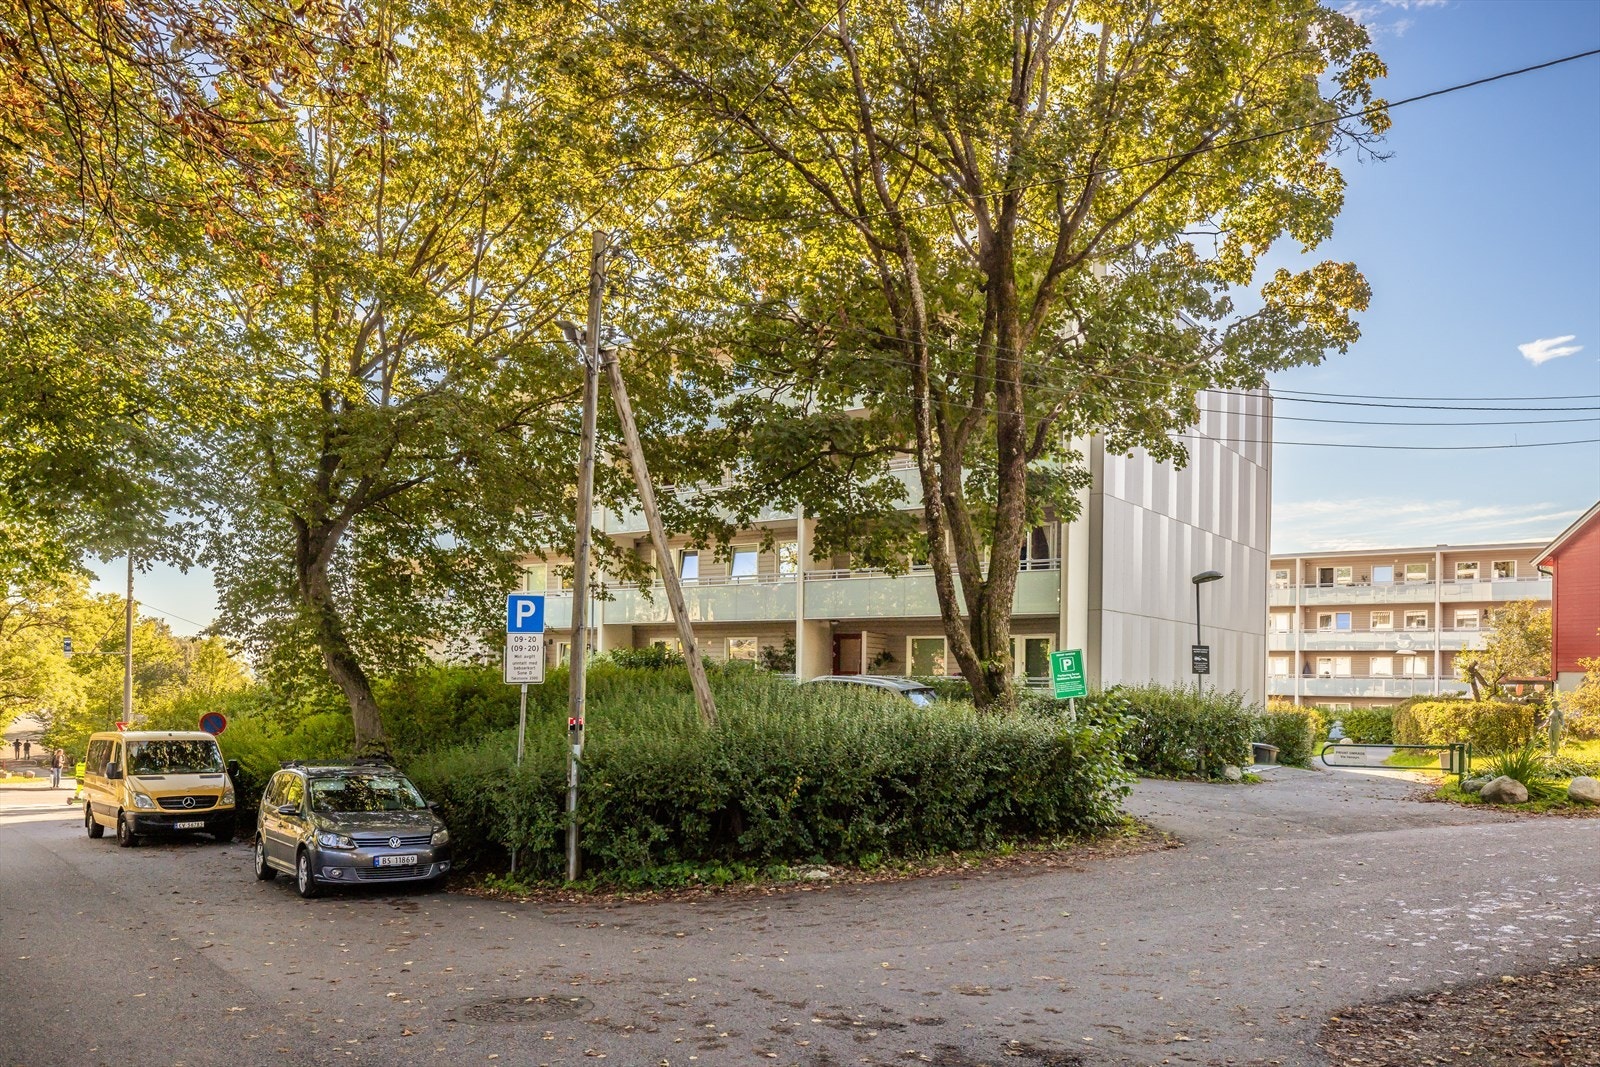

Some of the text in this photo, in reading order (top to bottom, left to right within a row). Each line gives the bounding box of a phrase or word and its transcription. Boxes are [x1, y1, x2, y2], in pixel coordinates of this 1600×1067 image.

[516, 599, 536, 628] P
[513, 635, 537, 643] 09-20
[1063, 659, 1072, 671] P
[382, 856, 415, 865] BS 11869
